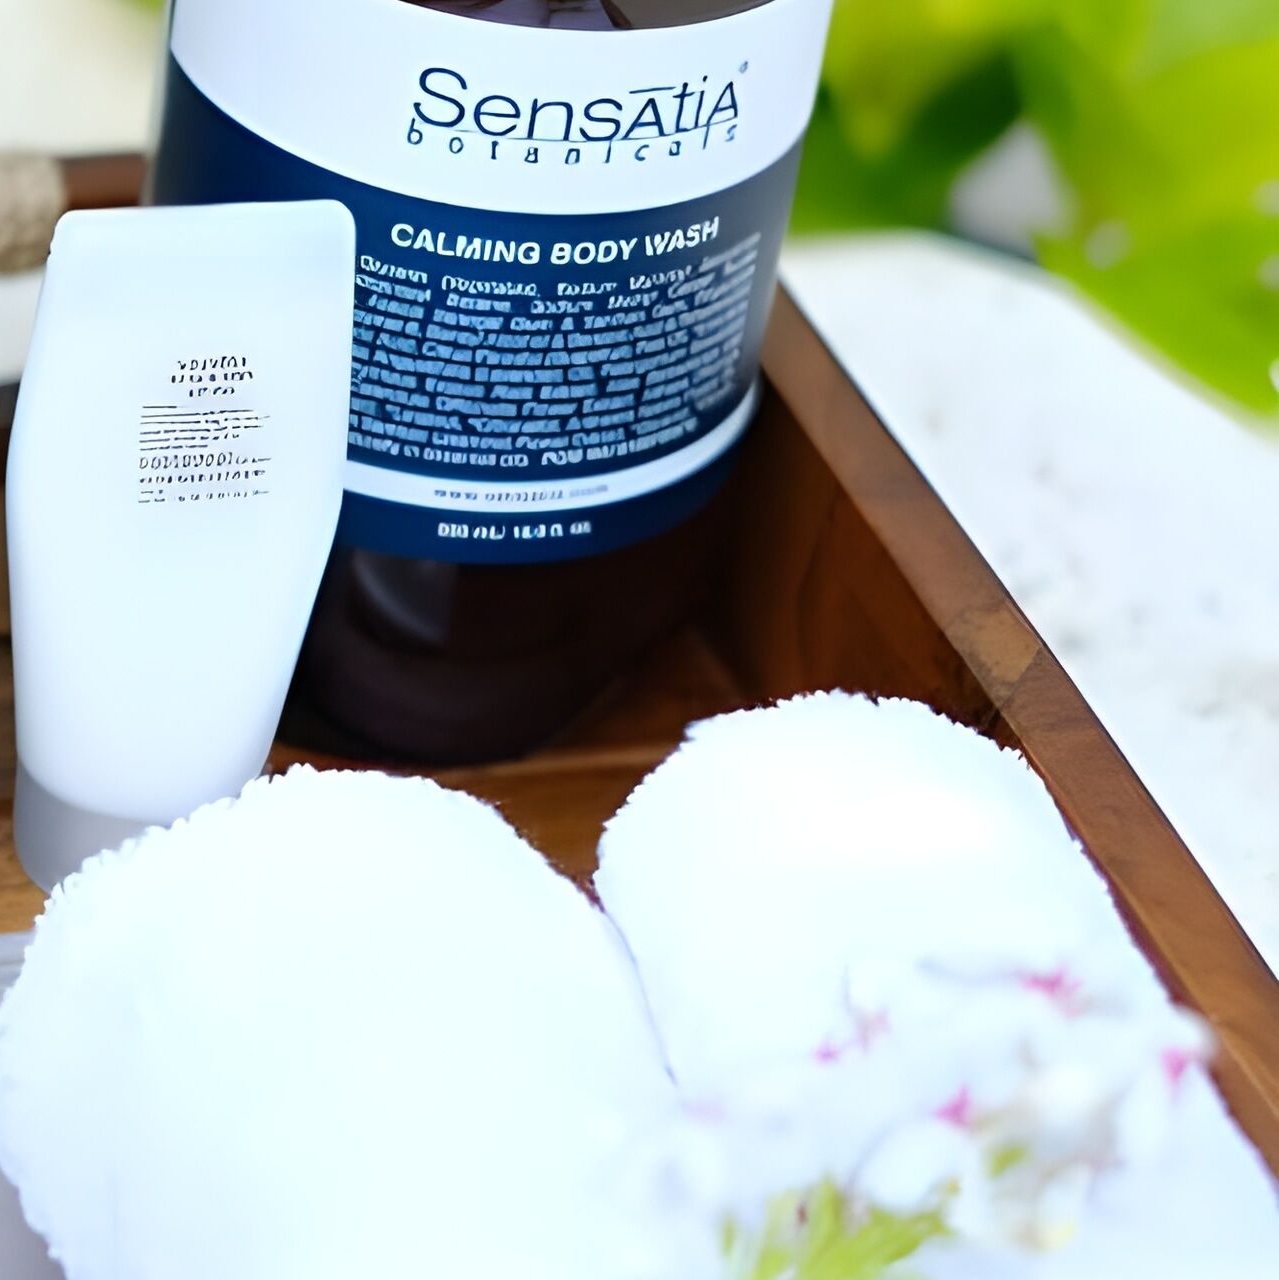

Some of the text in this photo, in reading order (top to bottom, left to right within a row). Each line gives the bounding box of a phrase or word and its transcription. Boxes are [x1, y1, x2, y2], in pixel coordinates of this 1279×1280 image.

[391, 223, 540, 264] CALMING
[550, 239, 638, 265] BODY
[644, 216, 720, 257] WASH
